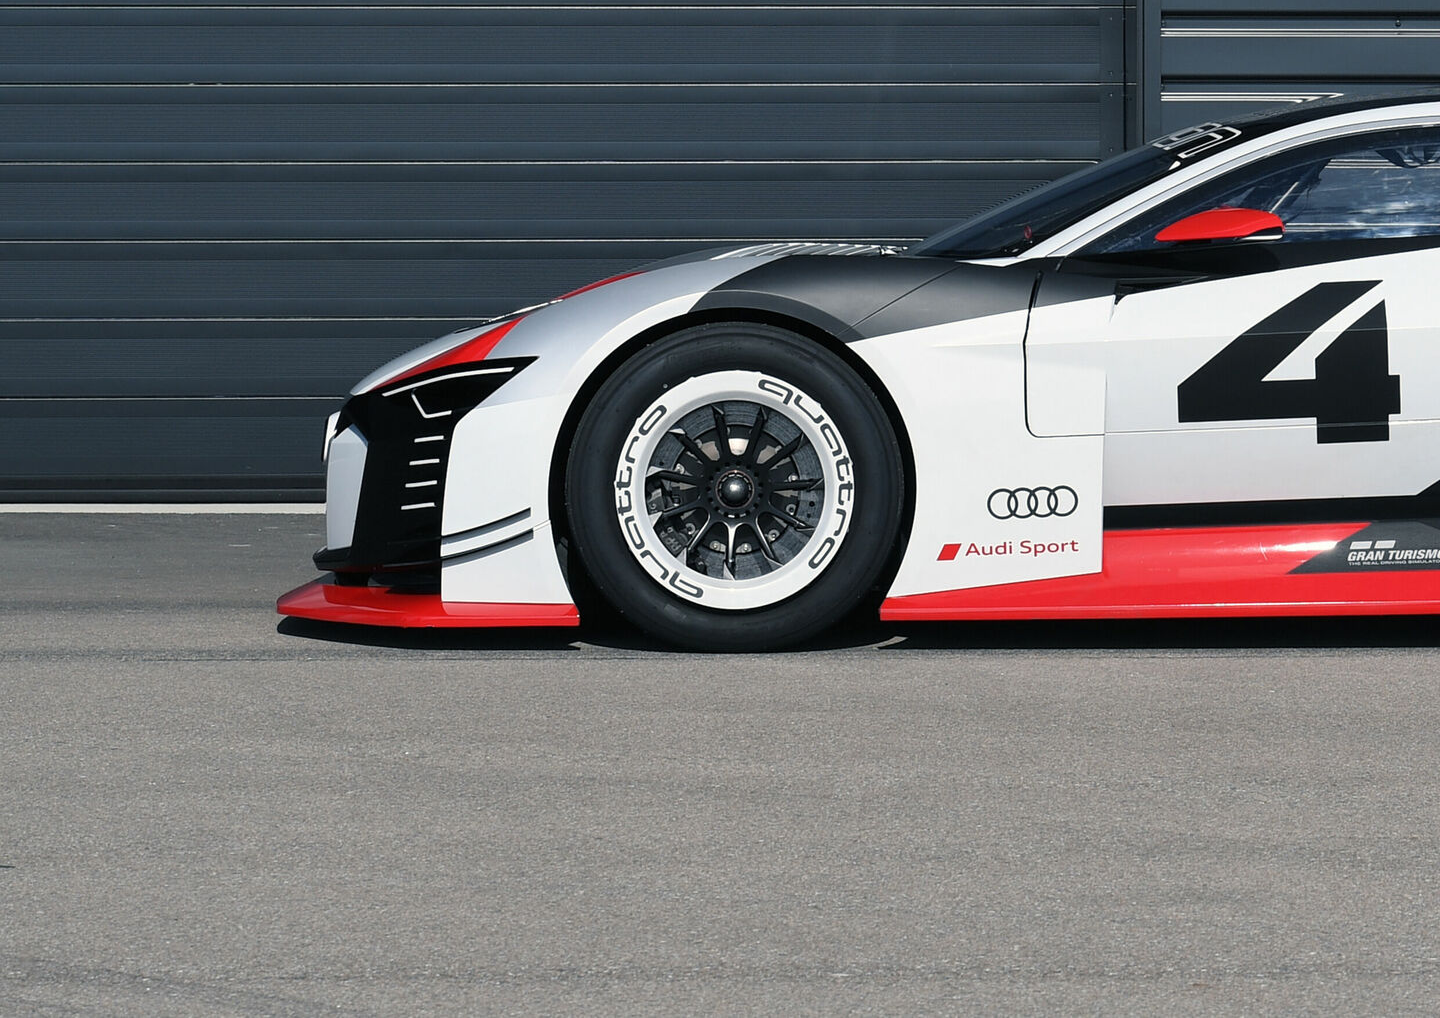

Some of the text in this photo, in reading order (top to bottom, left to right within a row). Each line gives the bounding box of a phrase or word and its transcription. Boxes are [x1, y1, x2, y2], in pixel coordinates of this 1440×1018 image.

[1177, 279, 1401, 444] 4
[615, 404, 704, 599] quattro
[758, 378, 854, 570] quattro
[964, 539, 1080, 557] Audi Sport
[1347, 550, 1385, 562] GRAN
